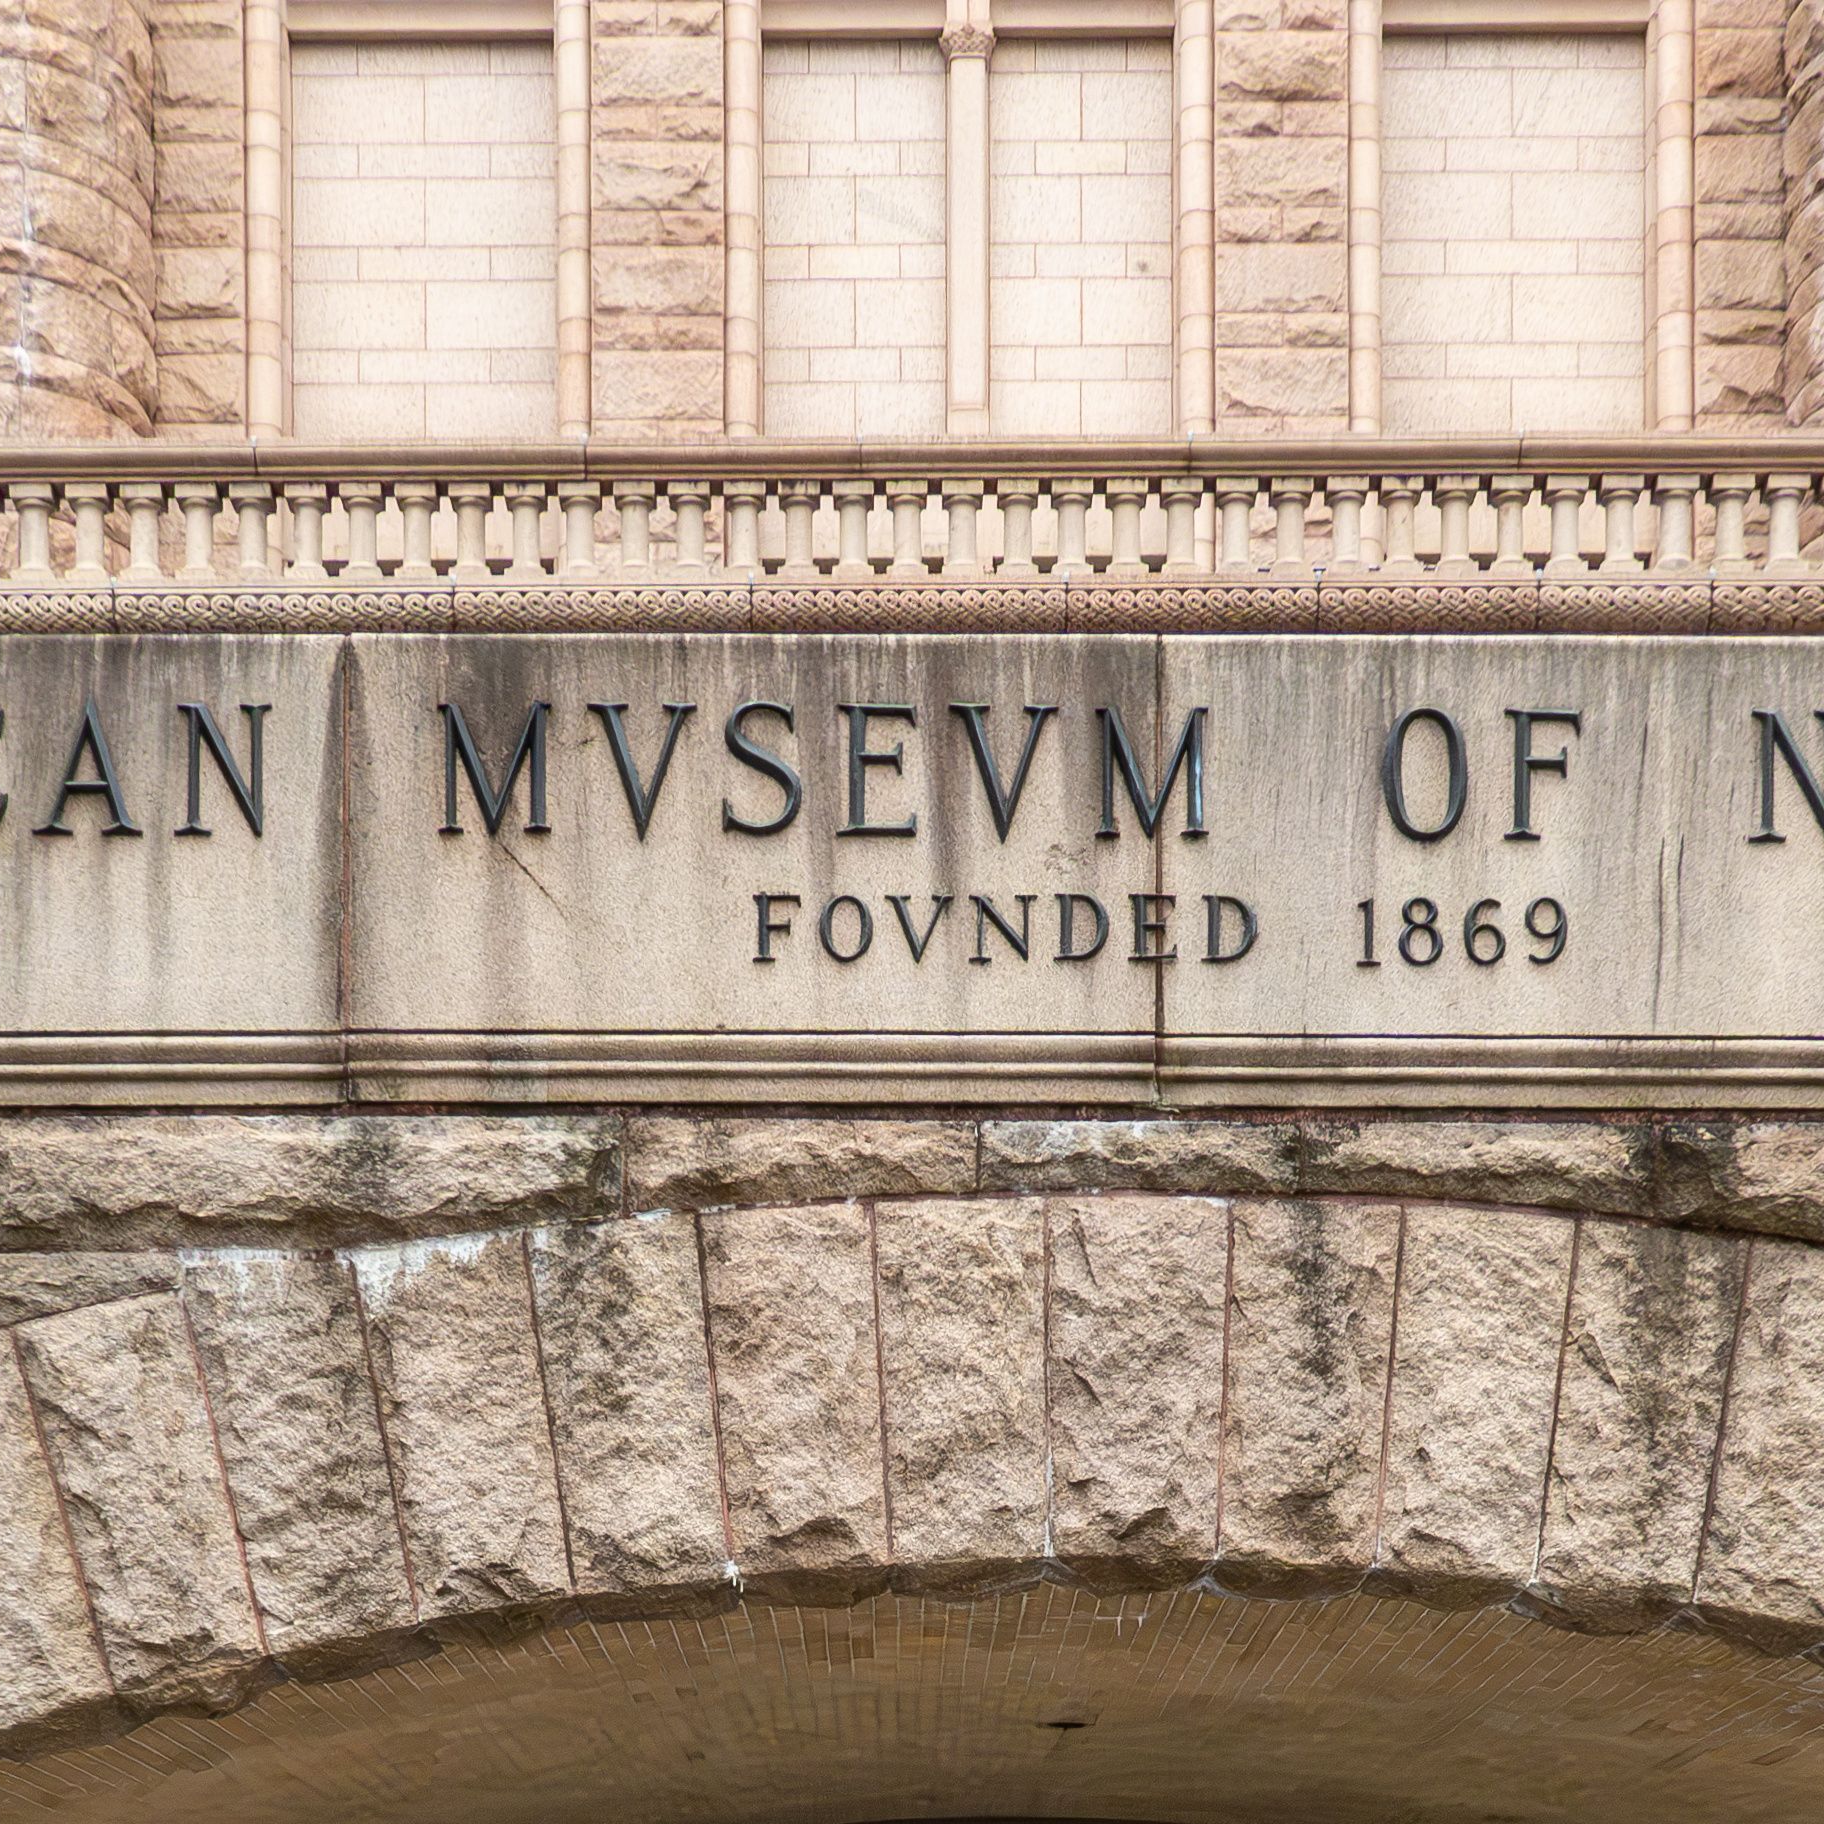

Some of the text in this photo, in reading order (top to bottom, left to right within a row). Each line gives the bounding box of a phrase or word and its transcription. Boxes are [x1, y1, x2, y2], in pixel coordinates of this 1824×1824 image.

[436, 700, 1210, 844] MVSEVM
[1381, 706, 1585, 844] OF
[751, 891, 1570, 968] FOVNDED 1869
